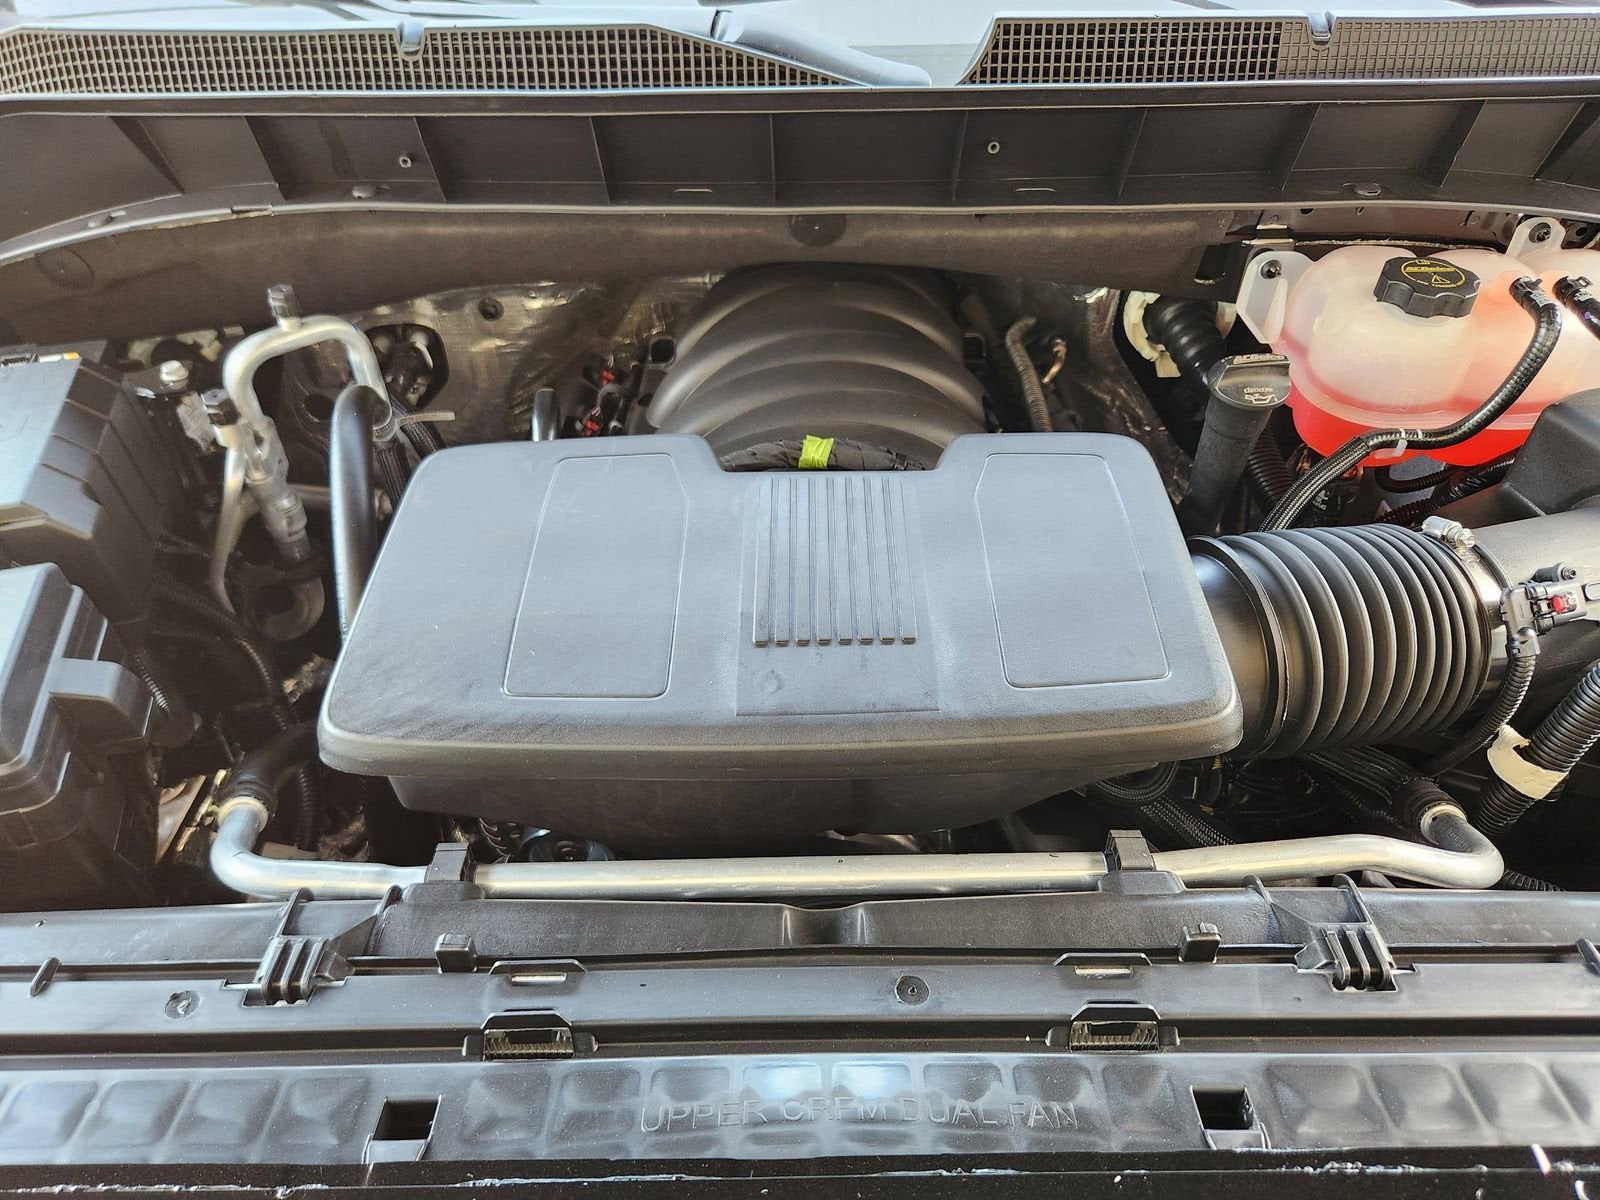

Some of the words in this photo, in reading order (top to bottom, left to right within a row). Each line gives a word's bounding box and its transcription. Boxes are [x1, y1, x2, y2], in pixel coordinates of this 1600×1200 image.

[1404, 265, 1457, 273] ACDelco
[1232, 353, 1286, 365] ACDelco
[640, 1099, 769, 1134] UPPER
[898, 1097, 1000, 1126] DUAL
[1008, 1101, 1079, 1130] FAN
